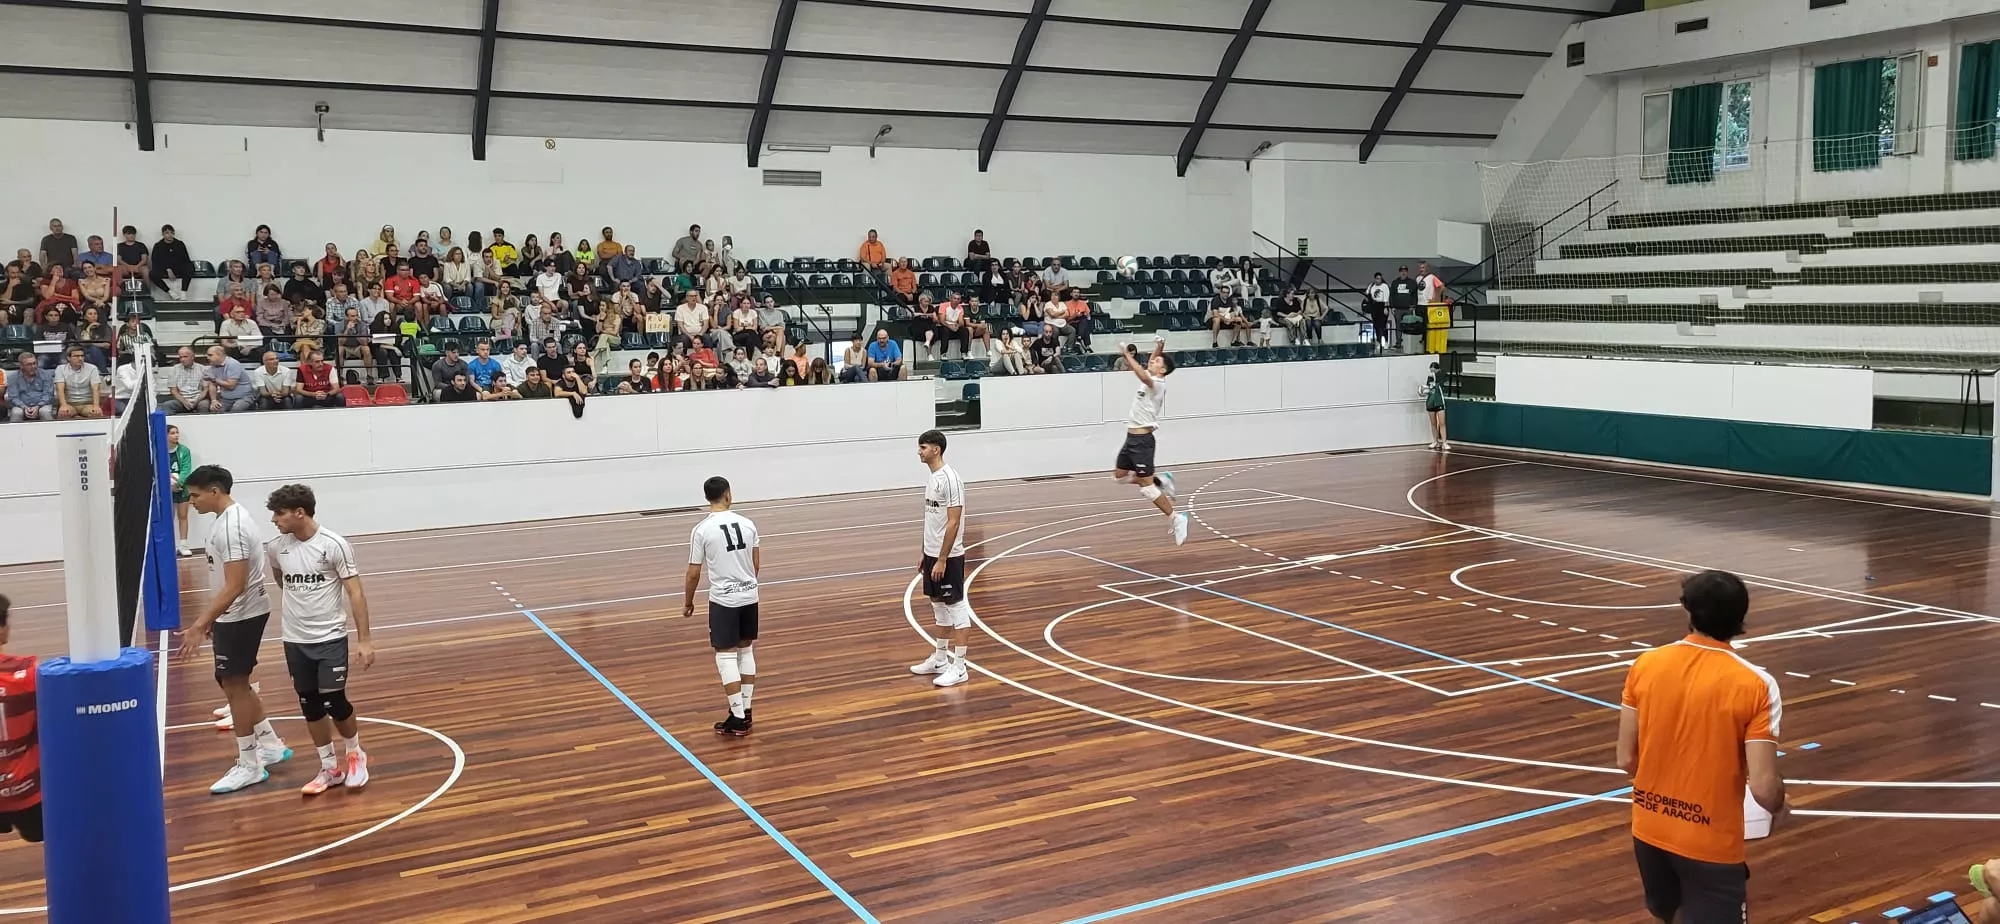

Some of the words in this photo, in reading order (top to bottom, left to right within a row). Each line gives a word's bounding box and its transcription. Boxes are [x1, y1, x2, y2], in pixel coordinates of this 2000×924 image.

[79, 456, 88, 491] MONDO
[171, 461, 178, 471] 4
[719, 522, 746, 552] 11
[88, 699, 138, 714] MONDO
[1645, 801, 1658, 812] DE
[1646, 792, 1703, 813] GOBIERNO
